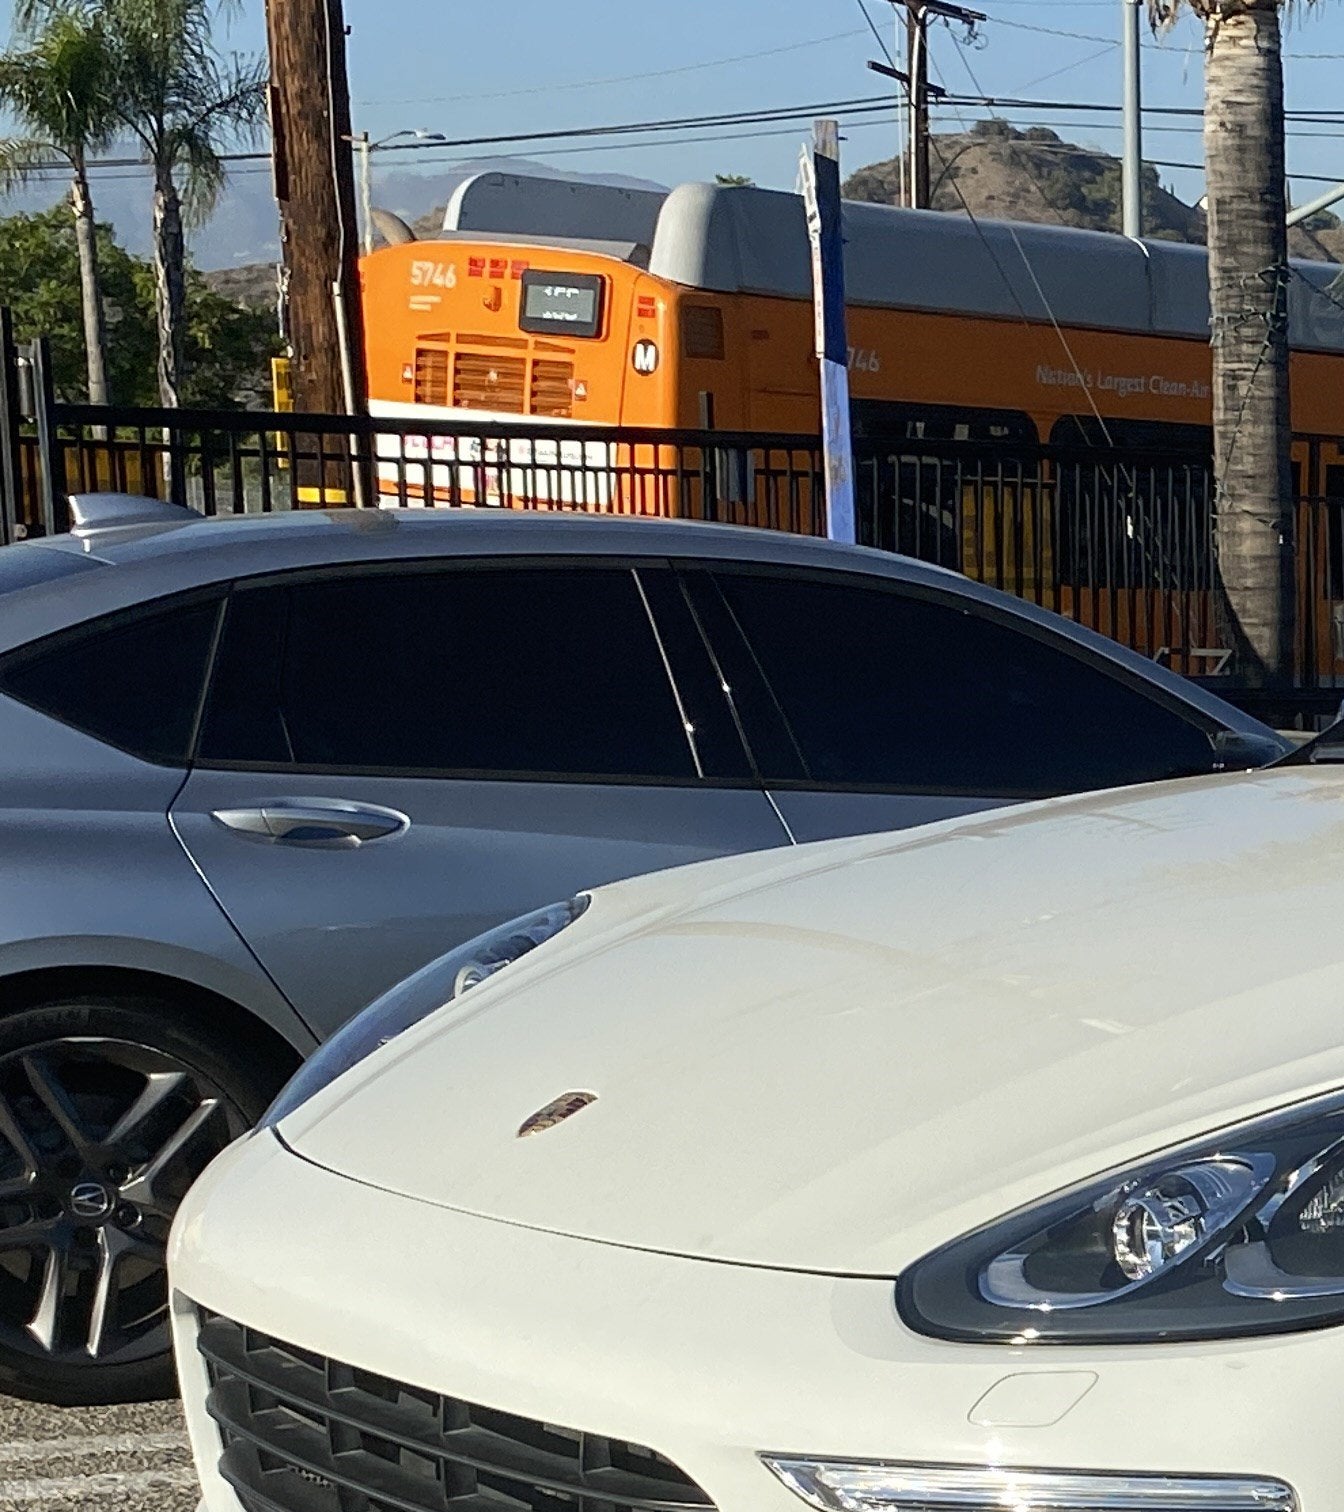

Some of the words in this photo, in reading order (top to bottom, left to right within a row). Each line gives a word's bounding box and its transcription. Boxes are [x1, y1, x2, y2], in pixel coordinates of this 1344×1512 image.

[410, 261, 457, 288] 5746
[635, 342, 656, 373] M
[846, 346, 880, 372] 746
[1099, 371, 1145, 397] Largest
